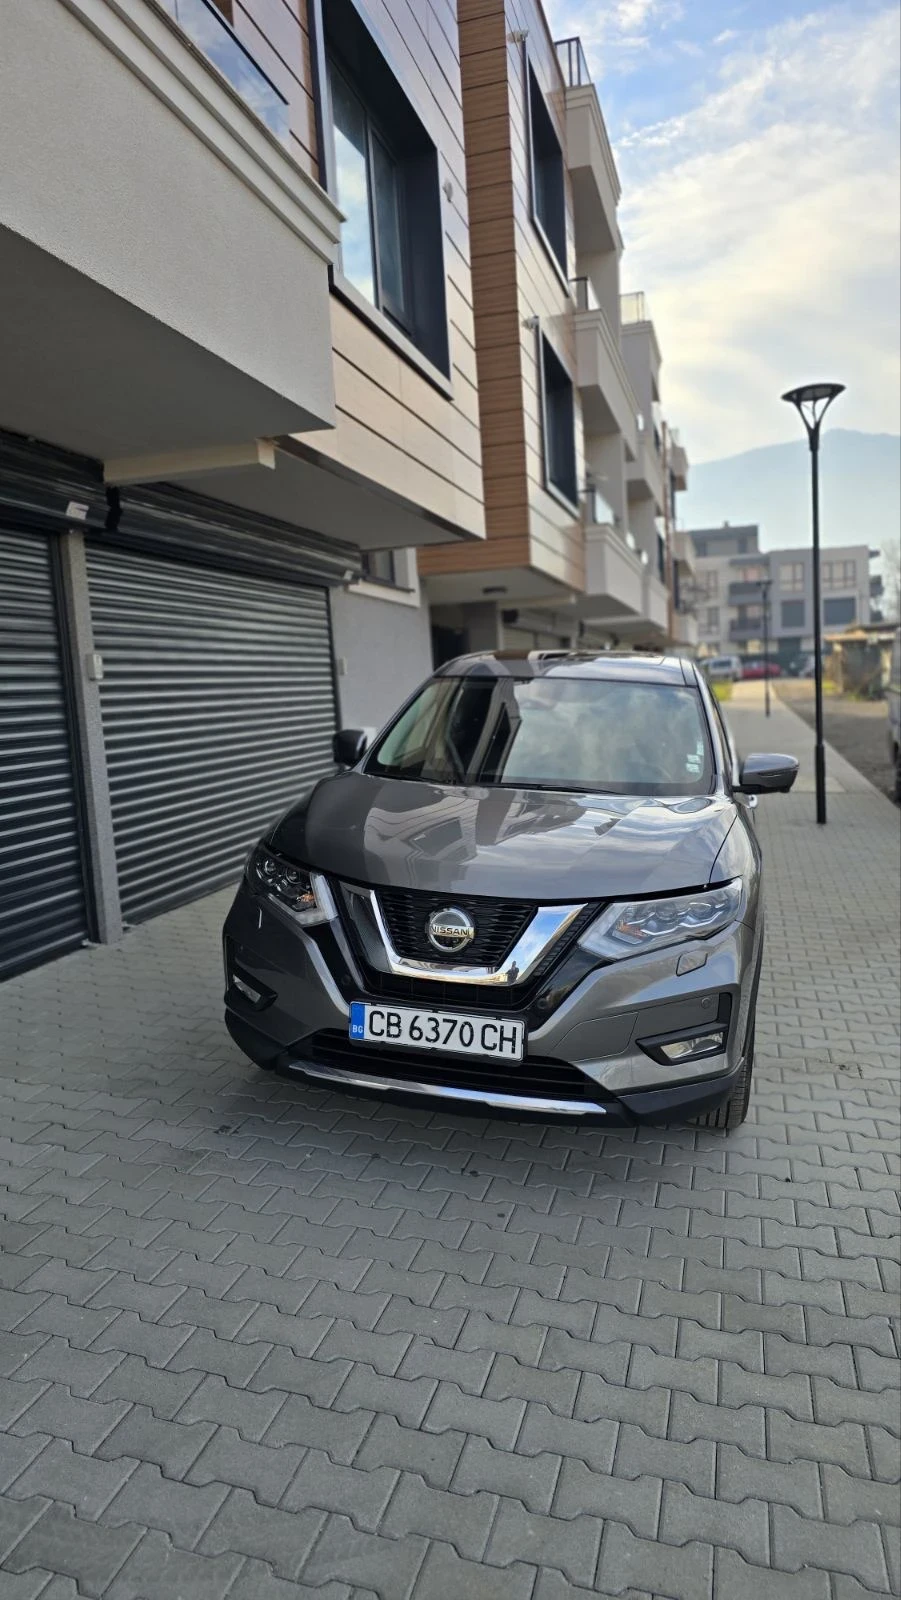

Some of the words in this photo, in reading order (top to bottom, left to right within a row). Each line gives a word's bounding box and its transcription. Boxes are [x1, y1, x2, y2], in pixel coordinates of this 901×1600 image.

[431, 925, 470, 936] NISSAN
[352, 1024, 364, 1034] BG
[369, 1010, 402, 1039] CB
[409, 1015, 475, 1047] 6370
[481, 1023, 517, 1054] CH
